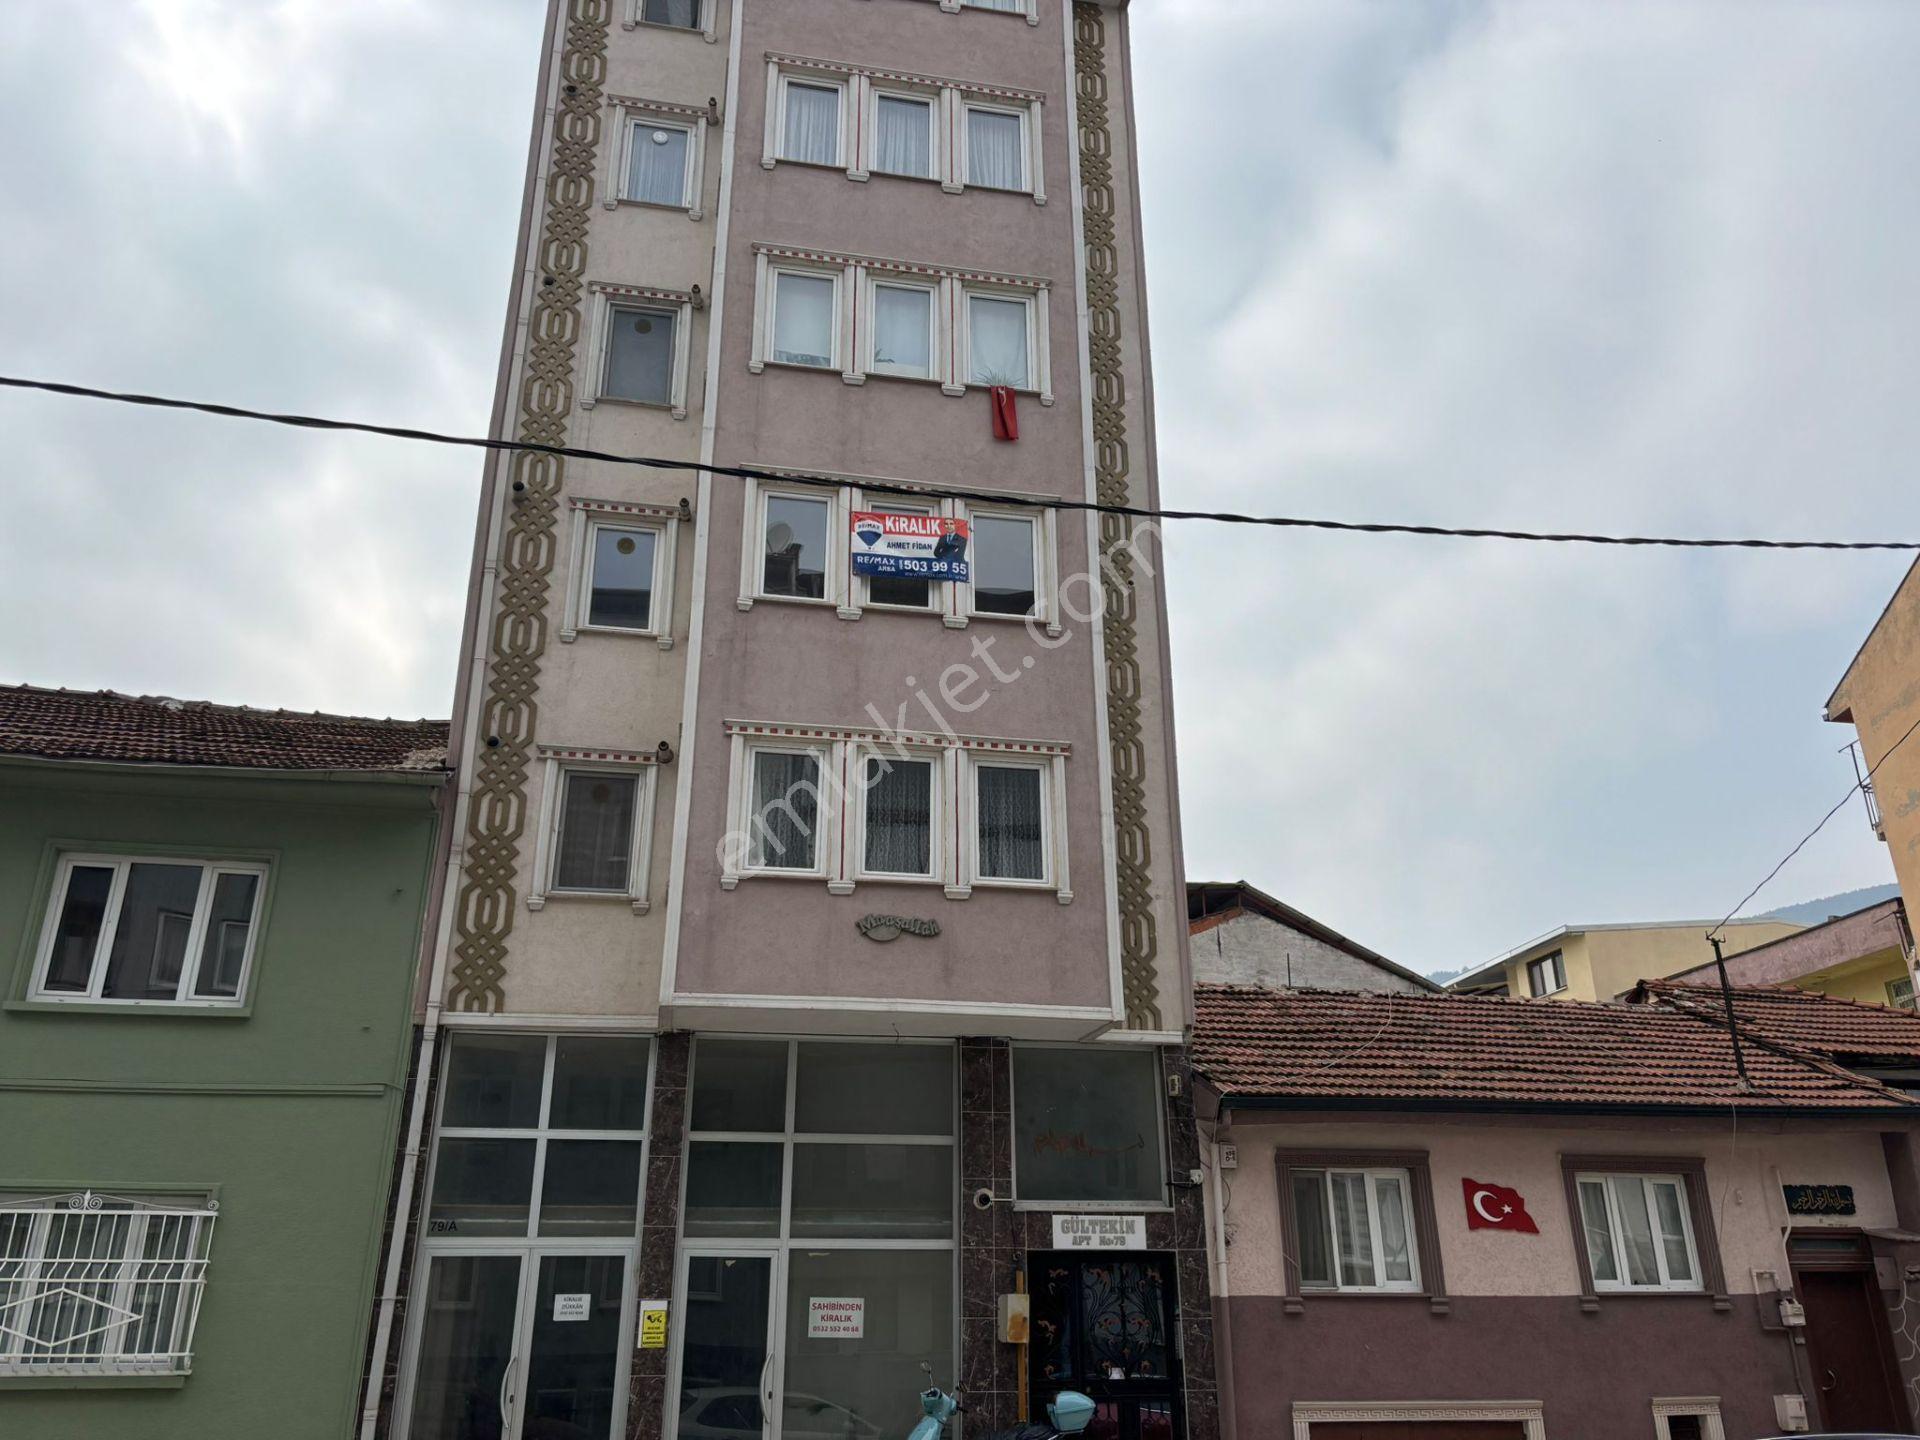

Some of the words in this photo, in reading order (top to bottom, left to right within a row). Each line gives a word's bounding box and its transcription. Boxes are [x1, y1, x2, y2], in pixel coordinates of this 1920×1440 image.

[886, 541, 910, 549] AHMET
[912, 542, 932, 550] FİDAN
[857, 556, 896, 566] RE/MAX
[904, 560, 927, 572] 503
[932, 562, 948, 572] 99
[952, 563, 967, 574] 55
[430, 1220, 458, 1232] 79/A
[1061, 1216, 1136, 1234] GÜLTEKİN
[1072, 1235, 1092, 1246] APT
[812, 1301, 862, 1311] SAHİBİNDEN
[820, 1313, 853, 1322] KİRALIK
